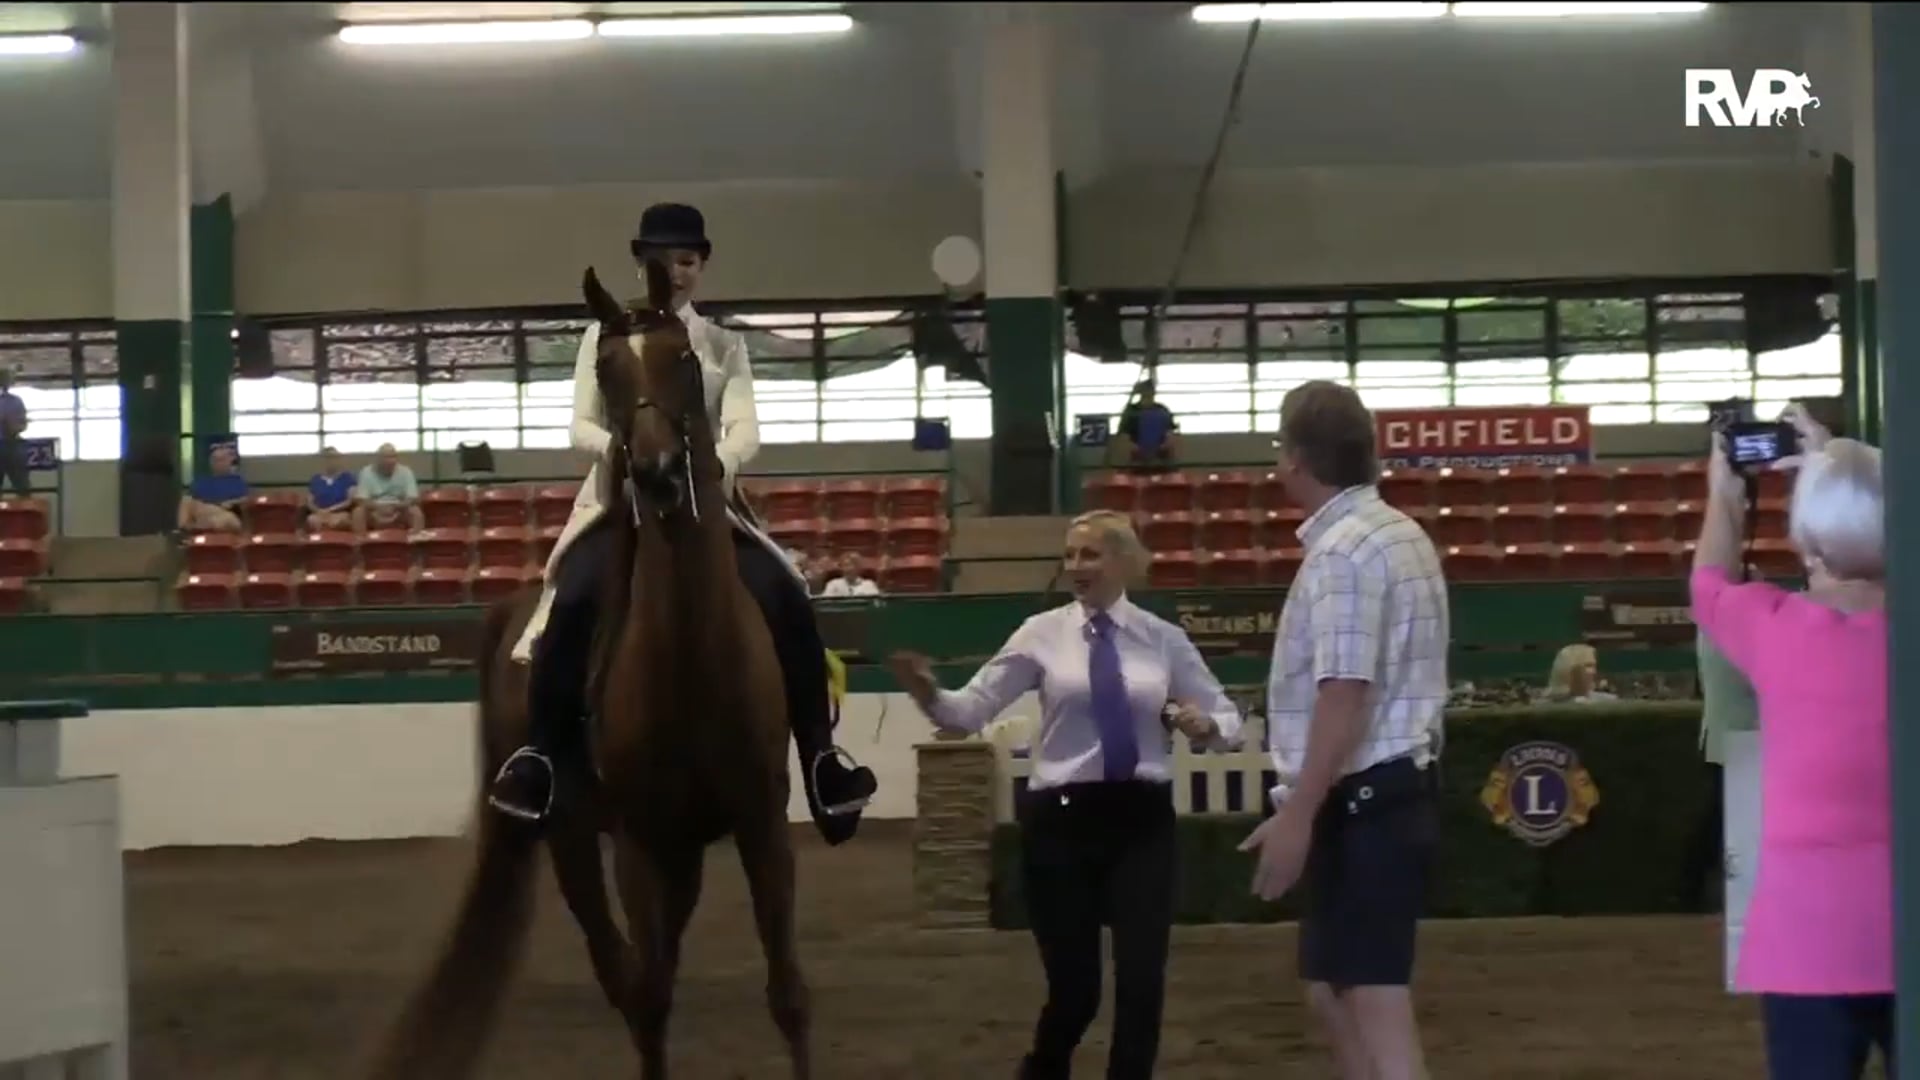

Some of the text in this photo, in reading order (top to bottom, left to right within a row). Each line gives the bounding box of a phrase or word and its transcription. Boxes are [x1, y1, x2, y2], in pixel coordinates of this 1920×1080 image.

[1081, 423, 1105, 443] 27
[316, 631, 442, 655] BANDSTAND
[1522, 774, 1559, 816] L
